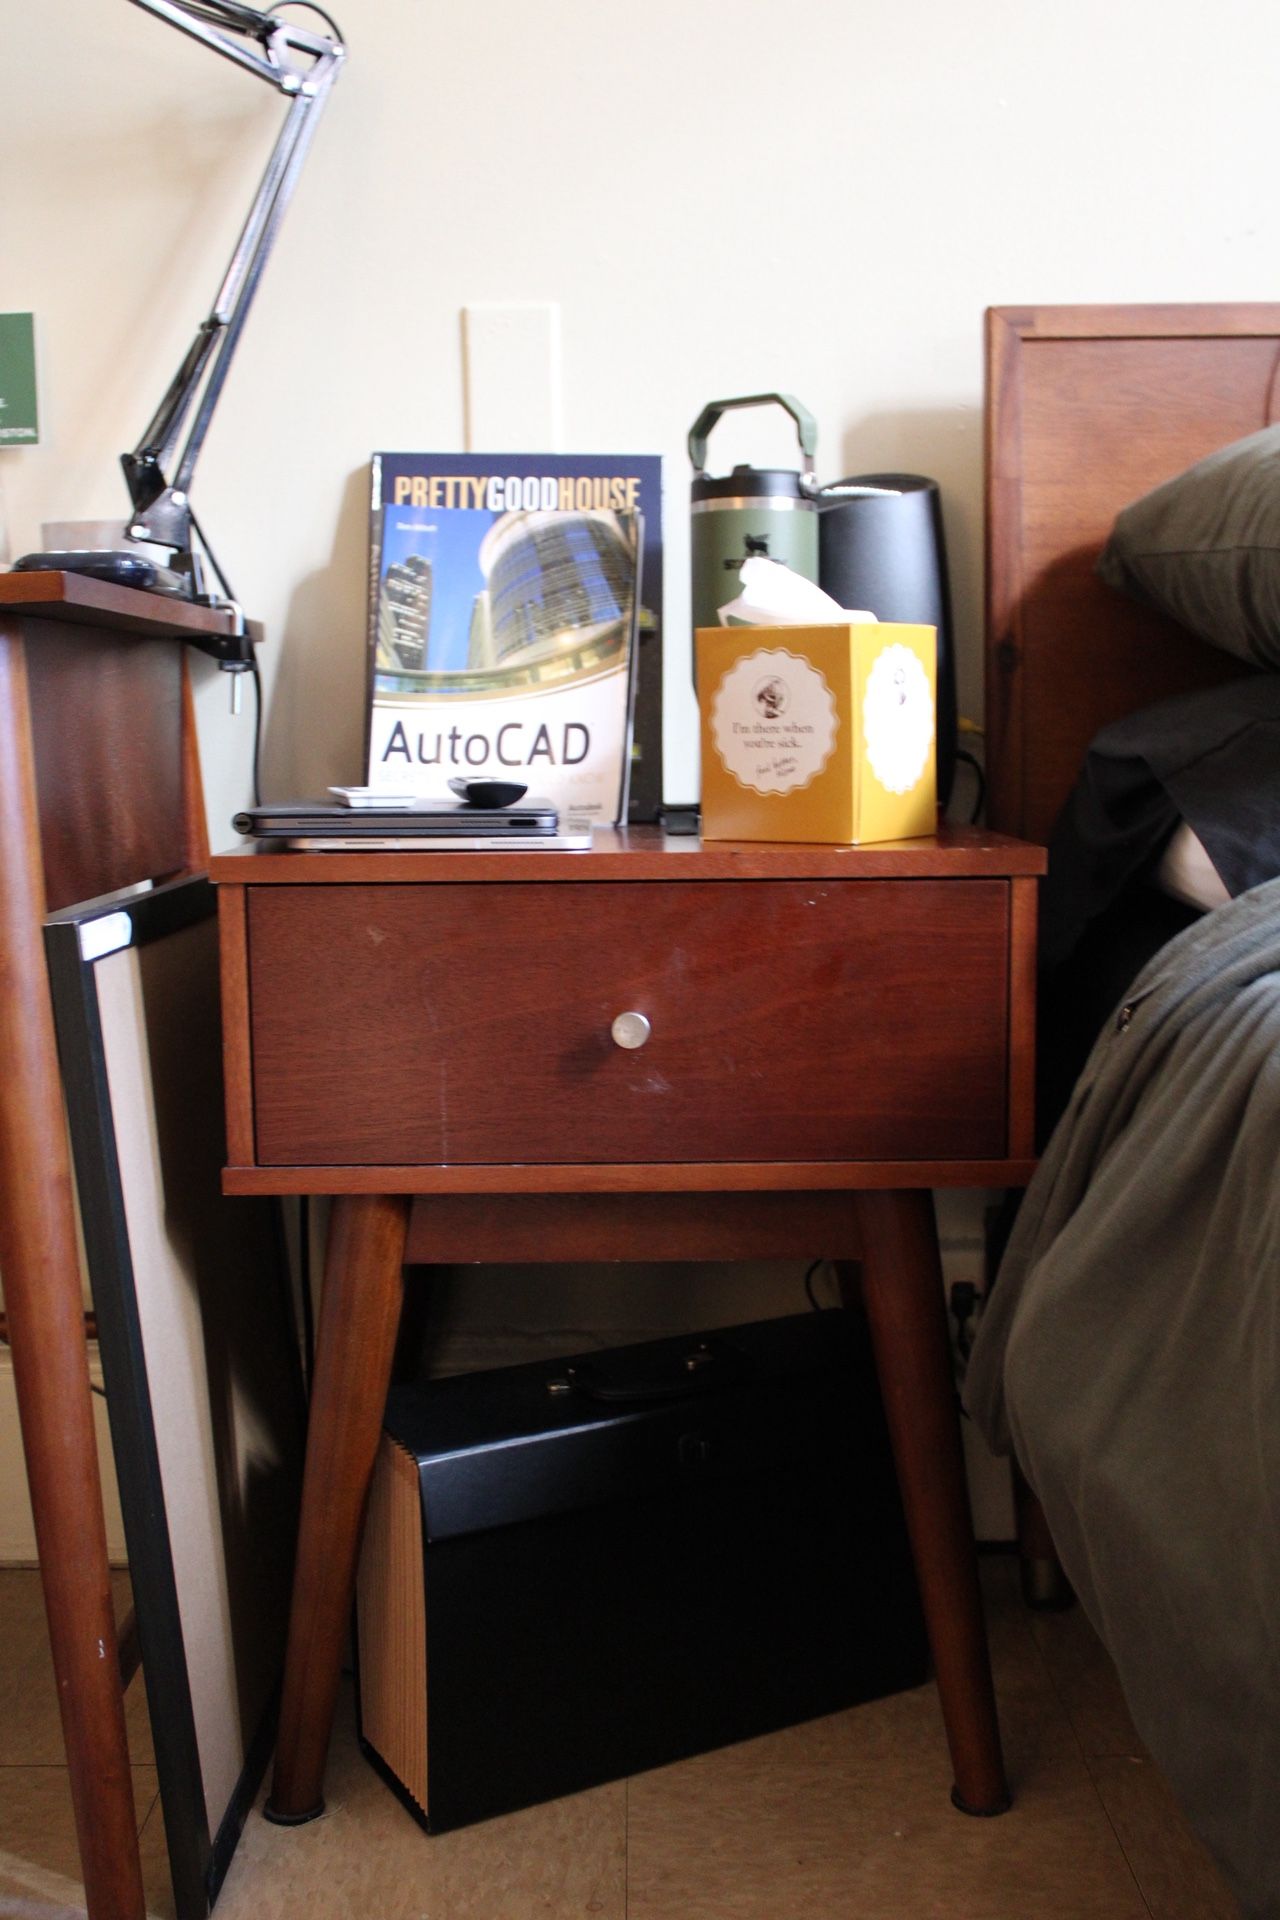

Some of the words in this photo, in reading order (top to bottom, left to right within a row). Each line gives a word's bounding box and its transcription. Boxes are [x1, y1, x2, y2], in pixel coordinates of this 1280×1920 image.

[752, 721, 780, 734] there
[782, 721, 815, 734] when
[381, 720, 591, 767] AutoCAD
